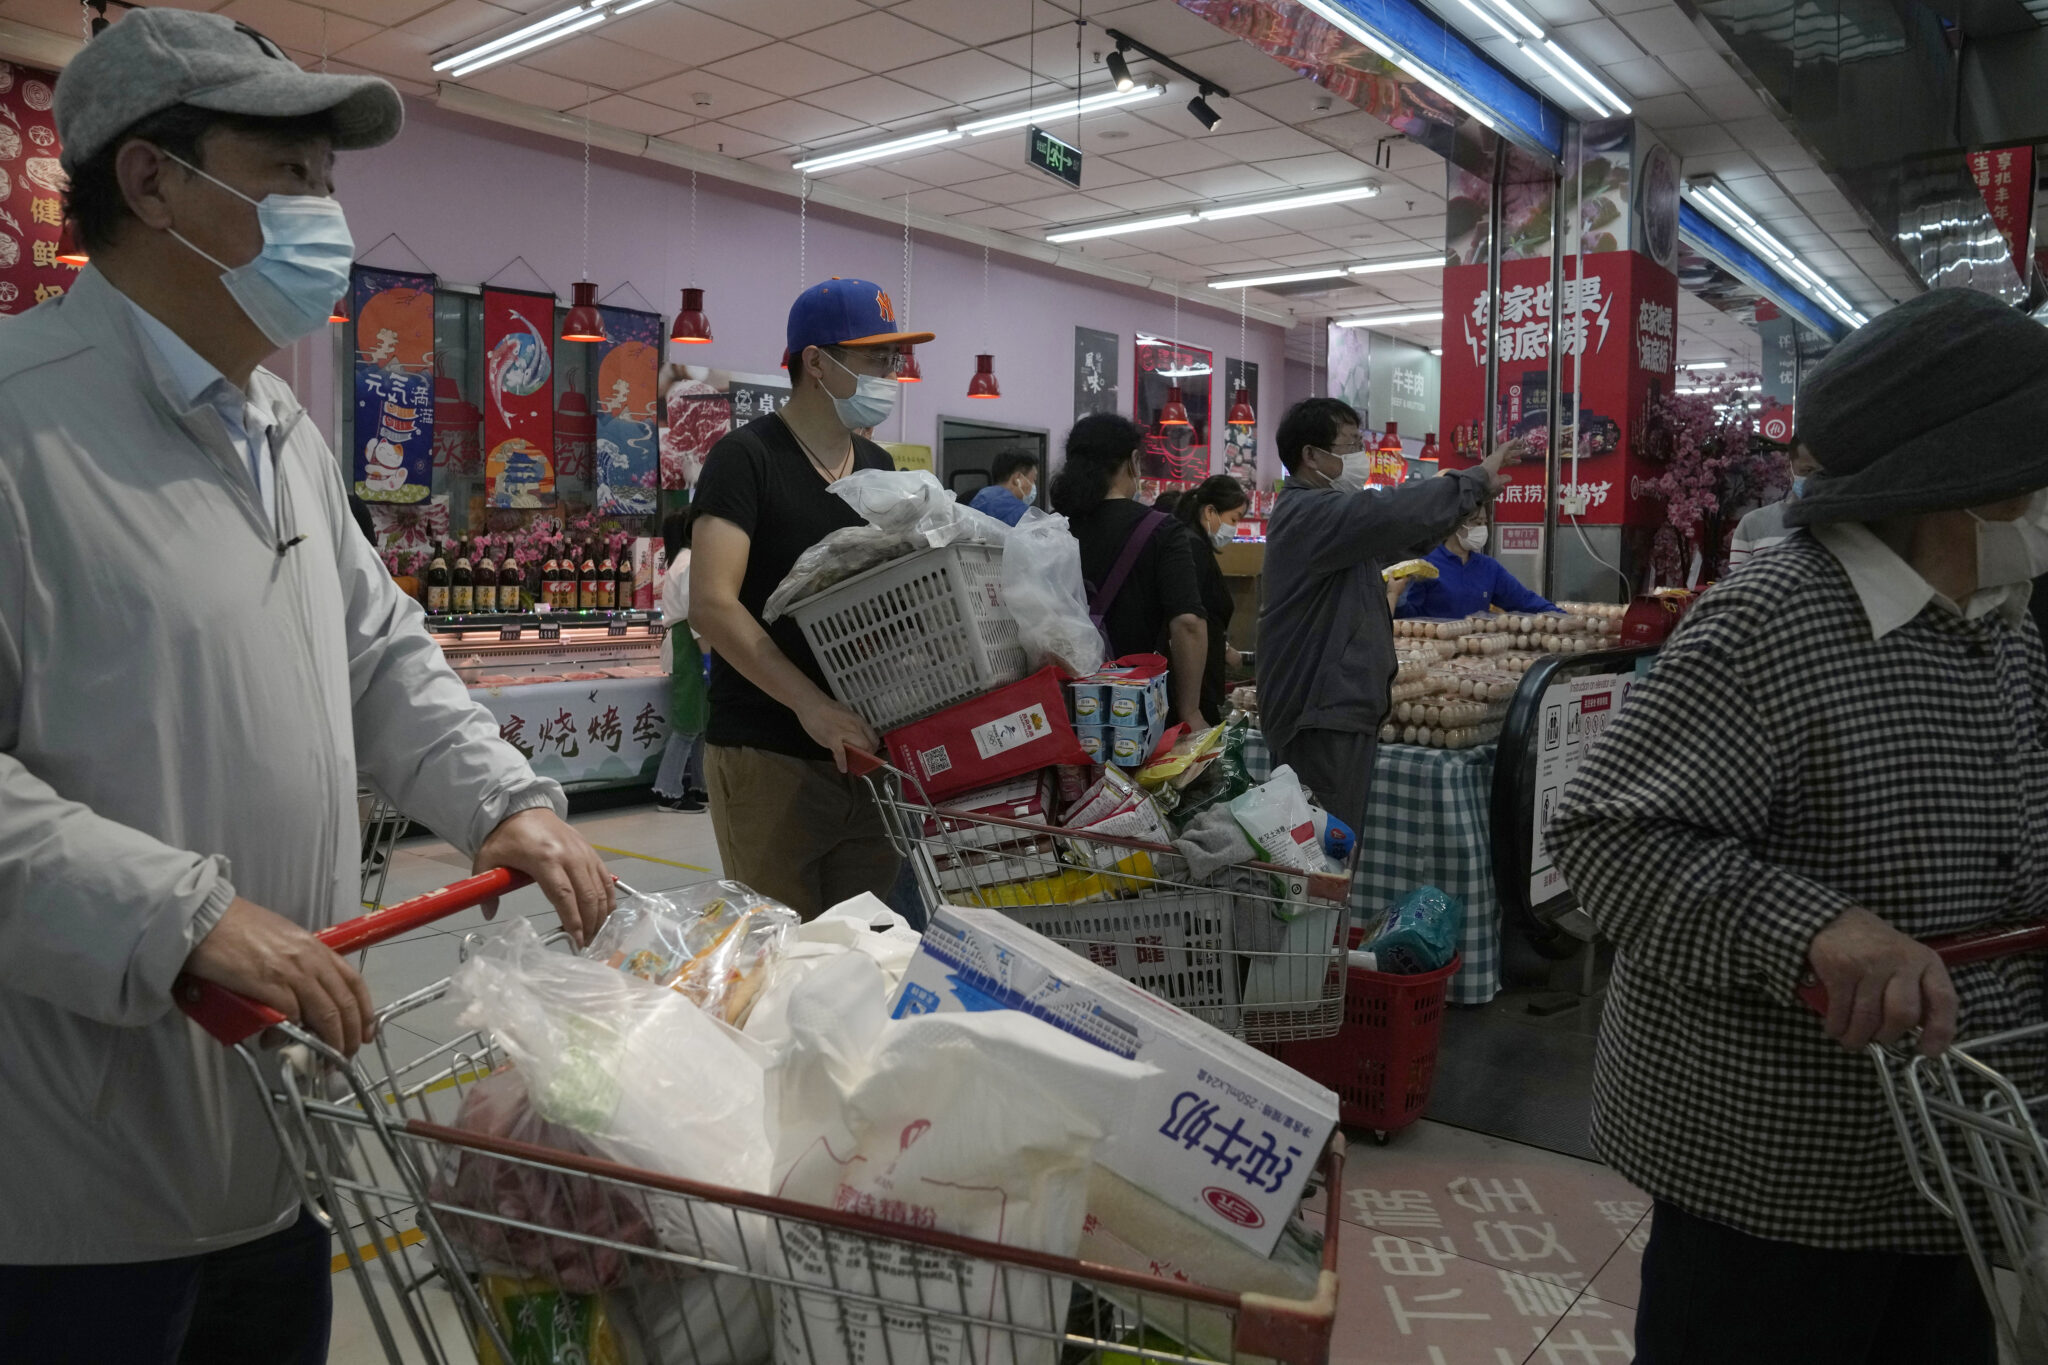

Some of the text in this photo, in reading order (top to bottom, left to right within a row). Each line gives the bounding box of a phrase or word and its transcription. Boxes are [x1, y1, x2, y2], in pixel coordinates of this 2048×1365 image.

[1471, 275, 1603, 327] 在家也要
[1639, 298, 1673, 339] 在家也要
[1479, 316, 1591, 365] 海底捞
[1641, 335, 1668, 374] 海底捞
[1393, 367, 1424, 397] 牛羊肉
[1158, 1090, 1303, 1194] 纯牛奶
[1214, 1196, 1251, 1225] 三元
